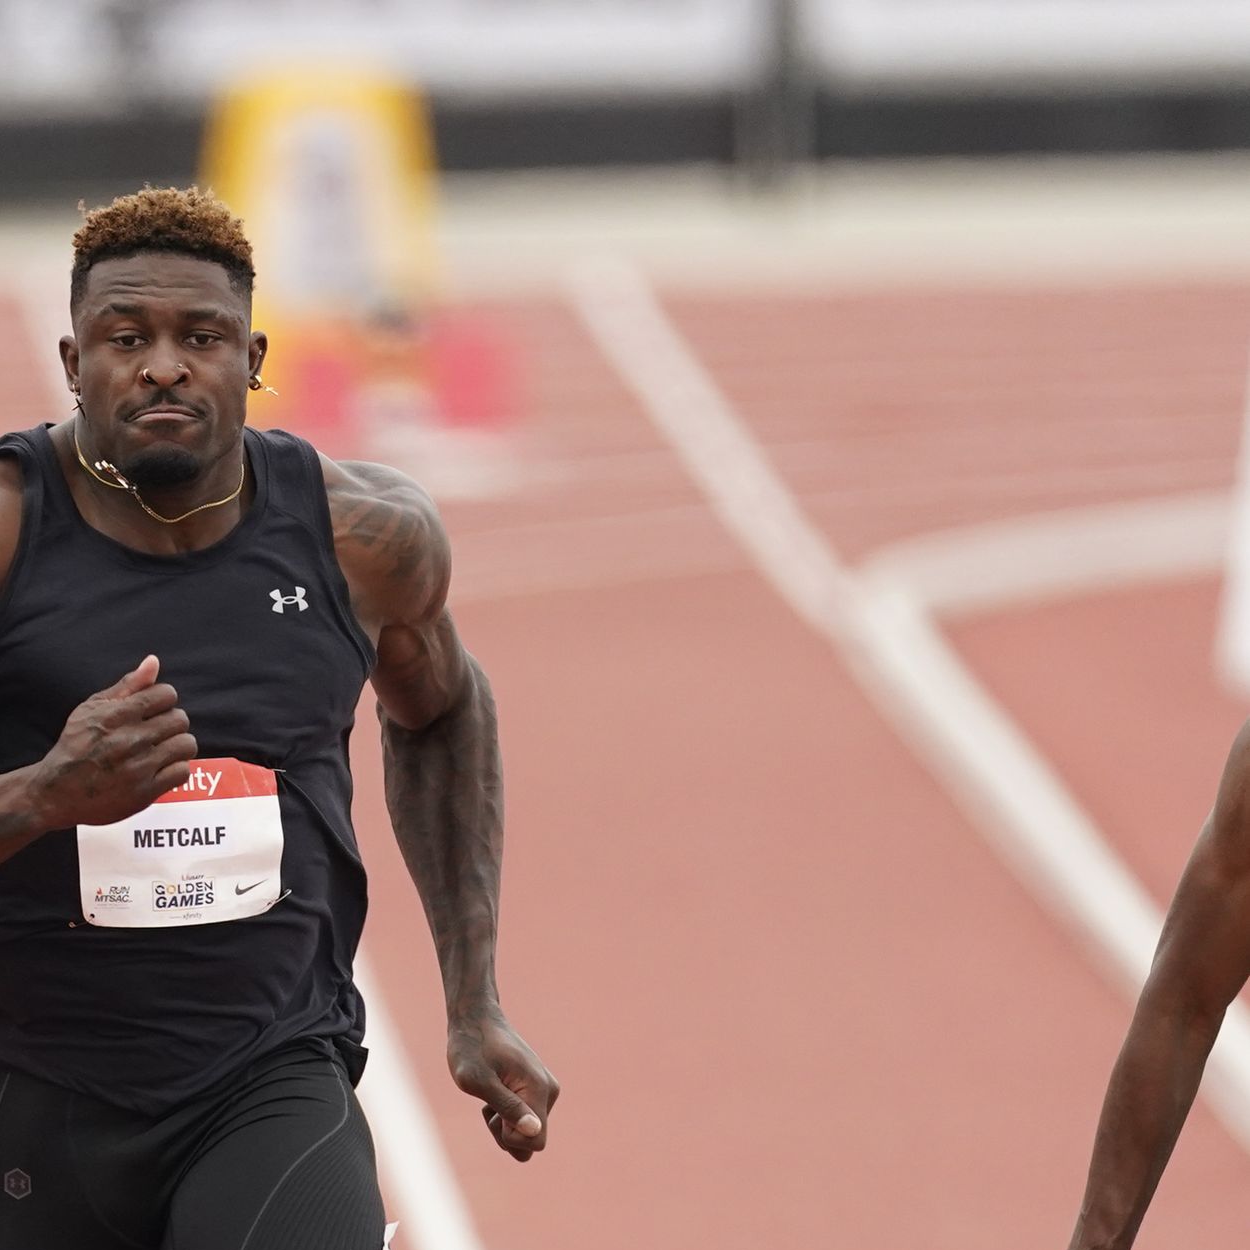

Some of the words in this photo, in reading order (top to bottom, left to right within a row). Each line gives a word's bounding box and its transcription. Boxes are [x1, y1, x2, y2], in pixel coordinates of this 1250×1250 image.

[172, 767, 222, 796] ity
[134, 826, 226, 848] METCALF
[155, 881, 213, 895] GOLDEN
[155, 892, 214, 908] GAMES
